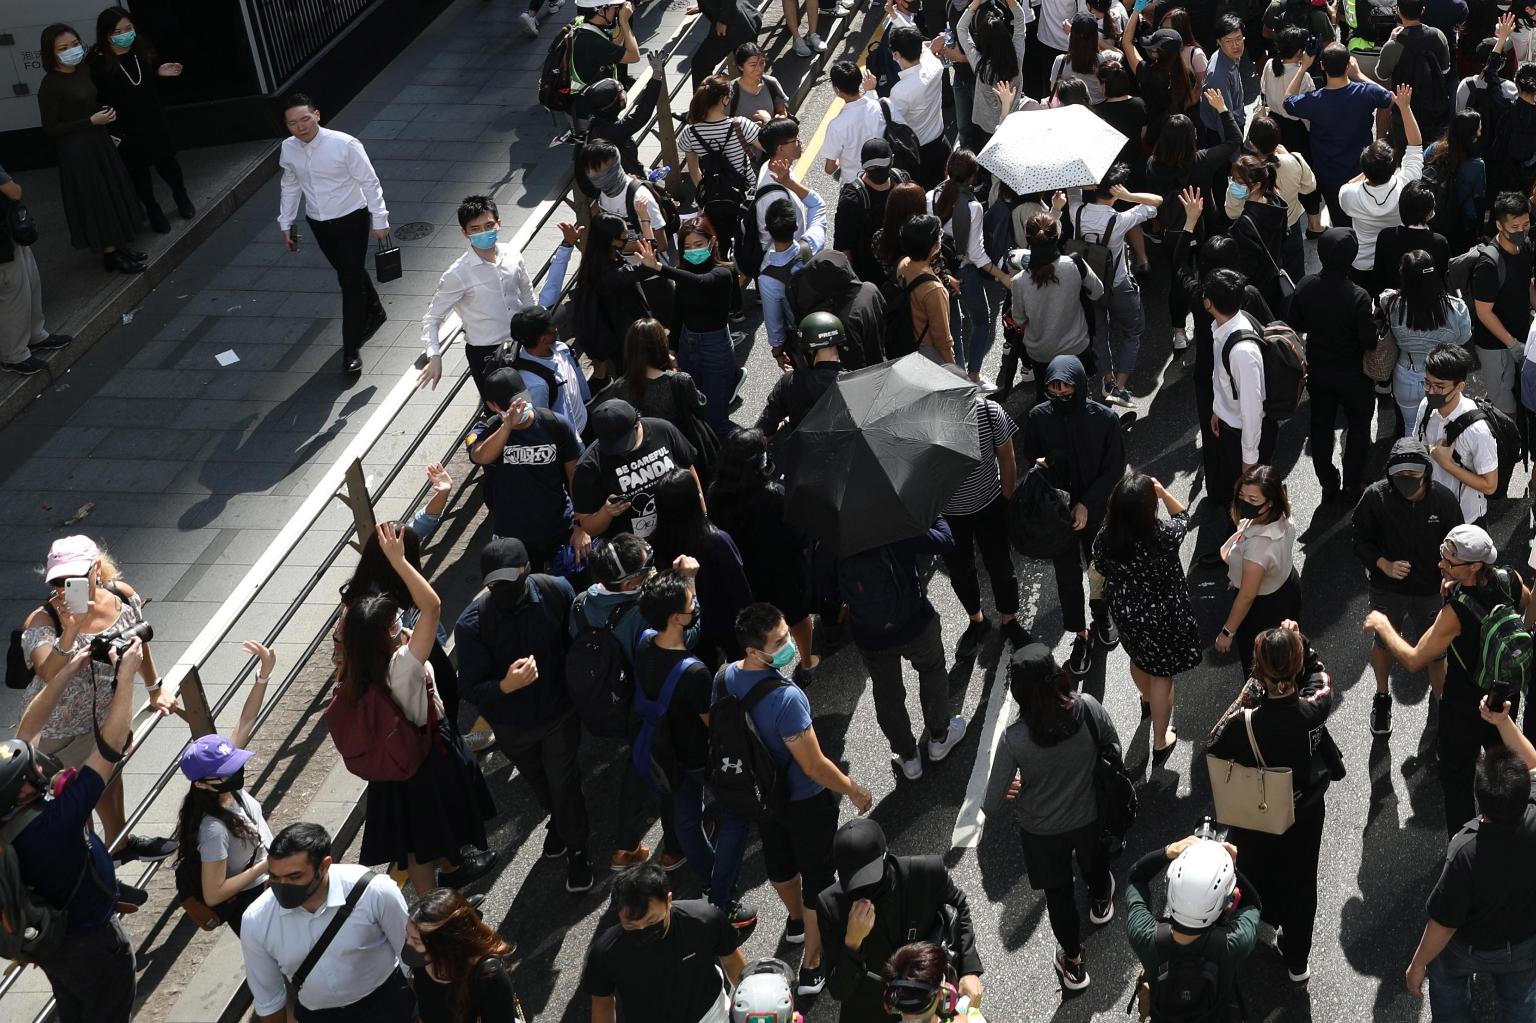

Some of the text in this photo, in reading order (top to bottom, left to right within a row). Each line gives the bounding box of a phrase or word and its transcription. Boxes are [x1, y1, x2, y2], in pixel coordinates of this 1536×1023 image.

[817, 330, 839, 339] PRESS
[615, 445, 670, 477] BE CAREFUL
[617, 455, 675, 493] PANDA
